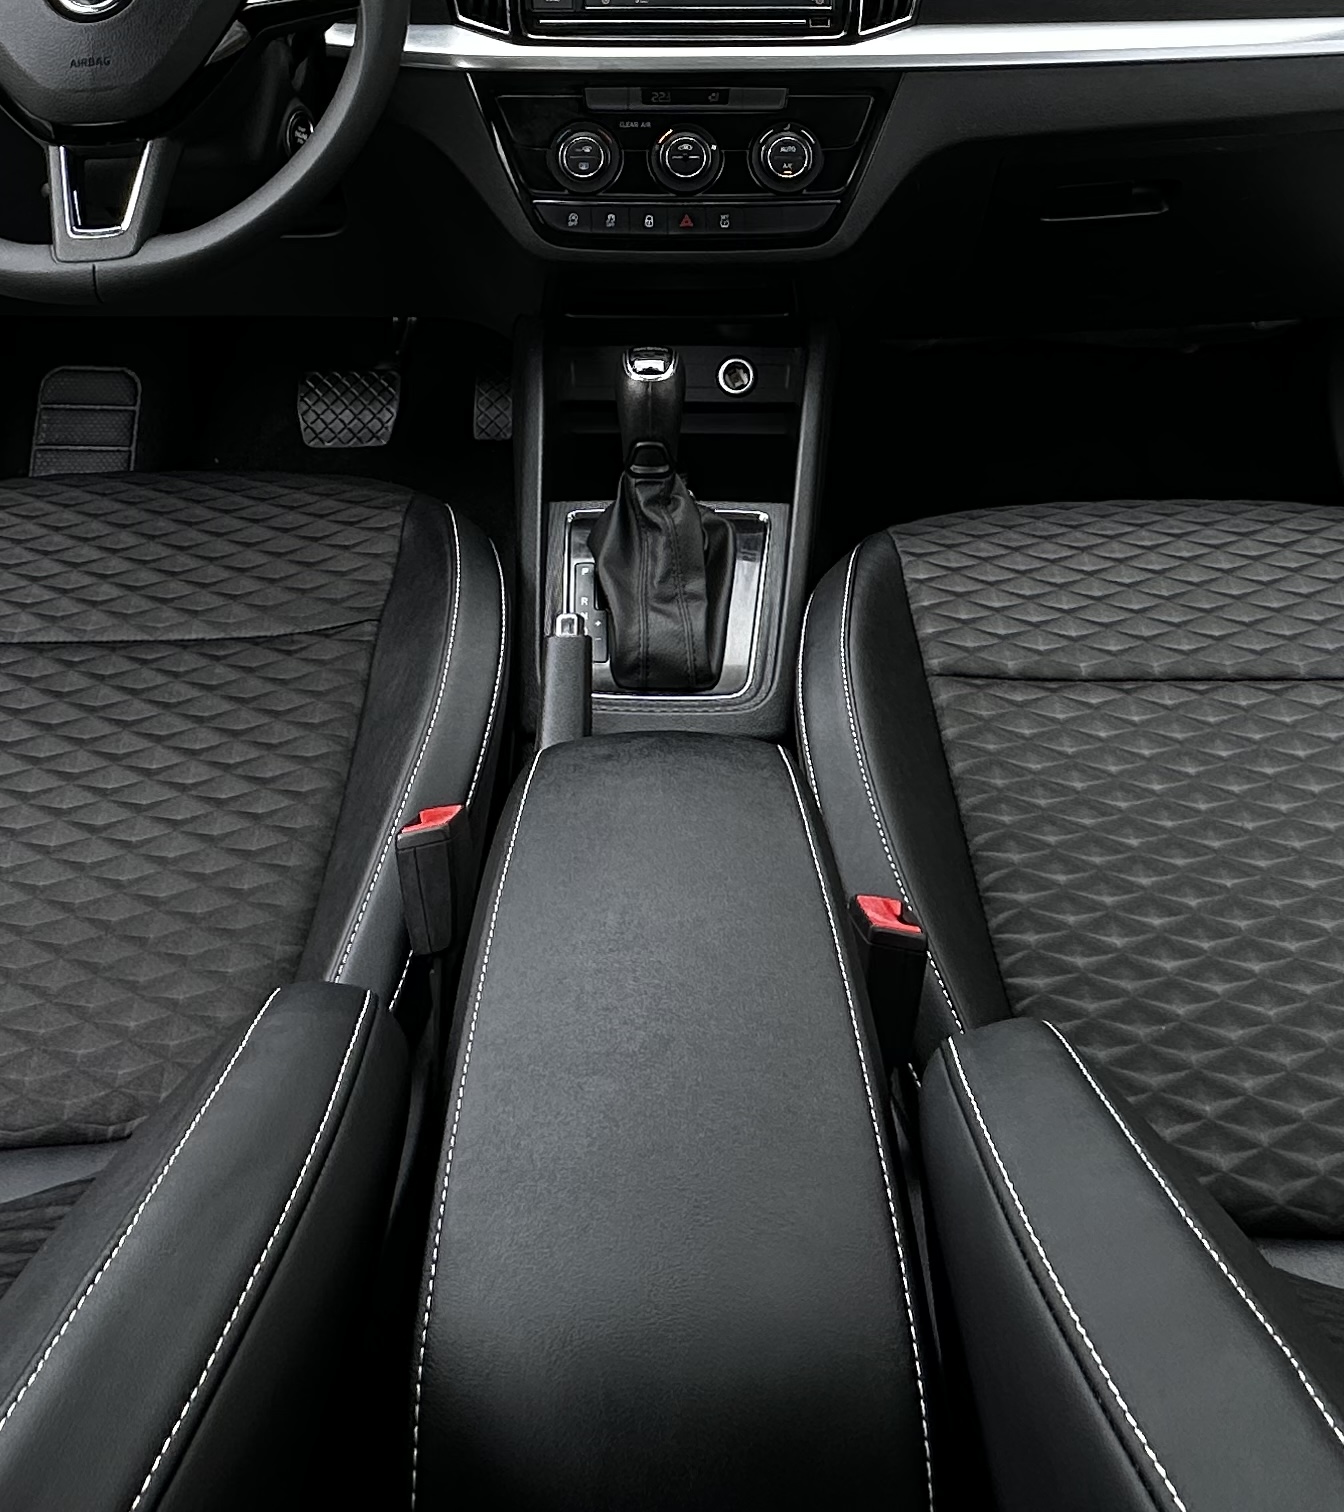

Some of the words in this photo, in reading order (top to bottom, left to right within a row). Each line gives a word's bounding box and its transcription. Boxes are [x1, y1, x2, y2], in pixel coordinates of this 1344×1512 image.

[70, 56, 111, 68] AIRBAG
[581, 567, 590, 576] P
[580, 596, 589, 606] R
